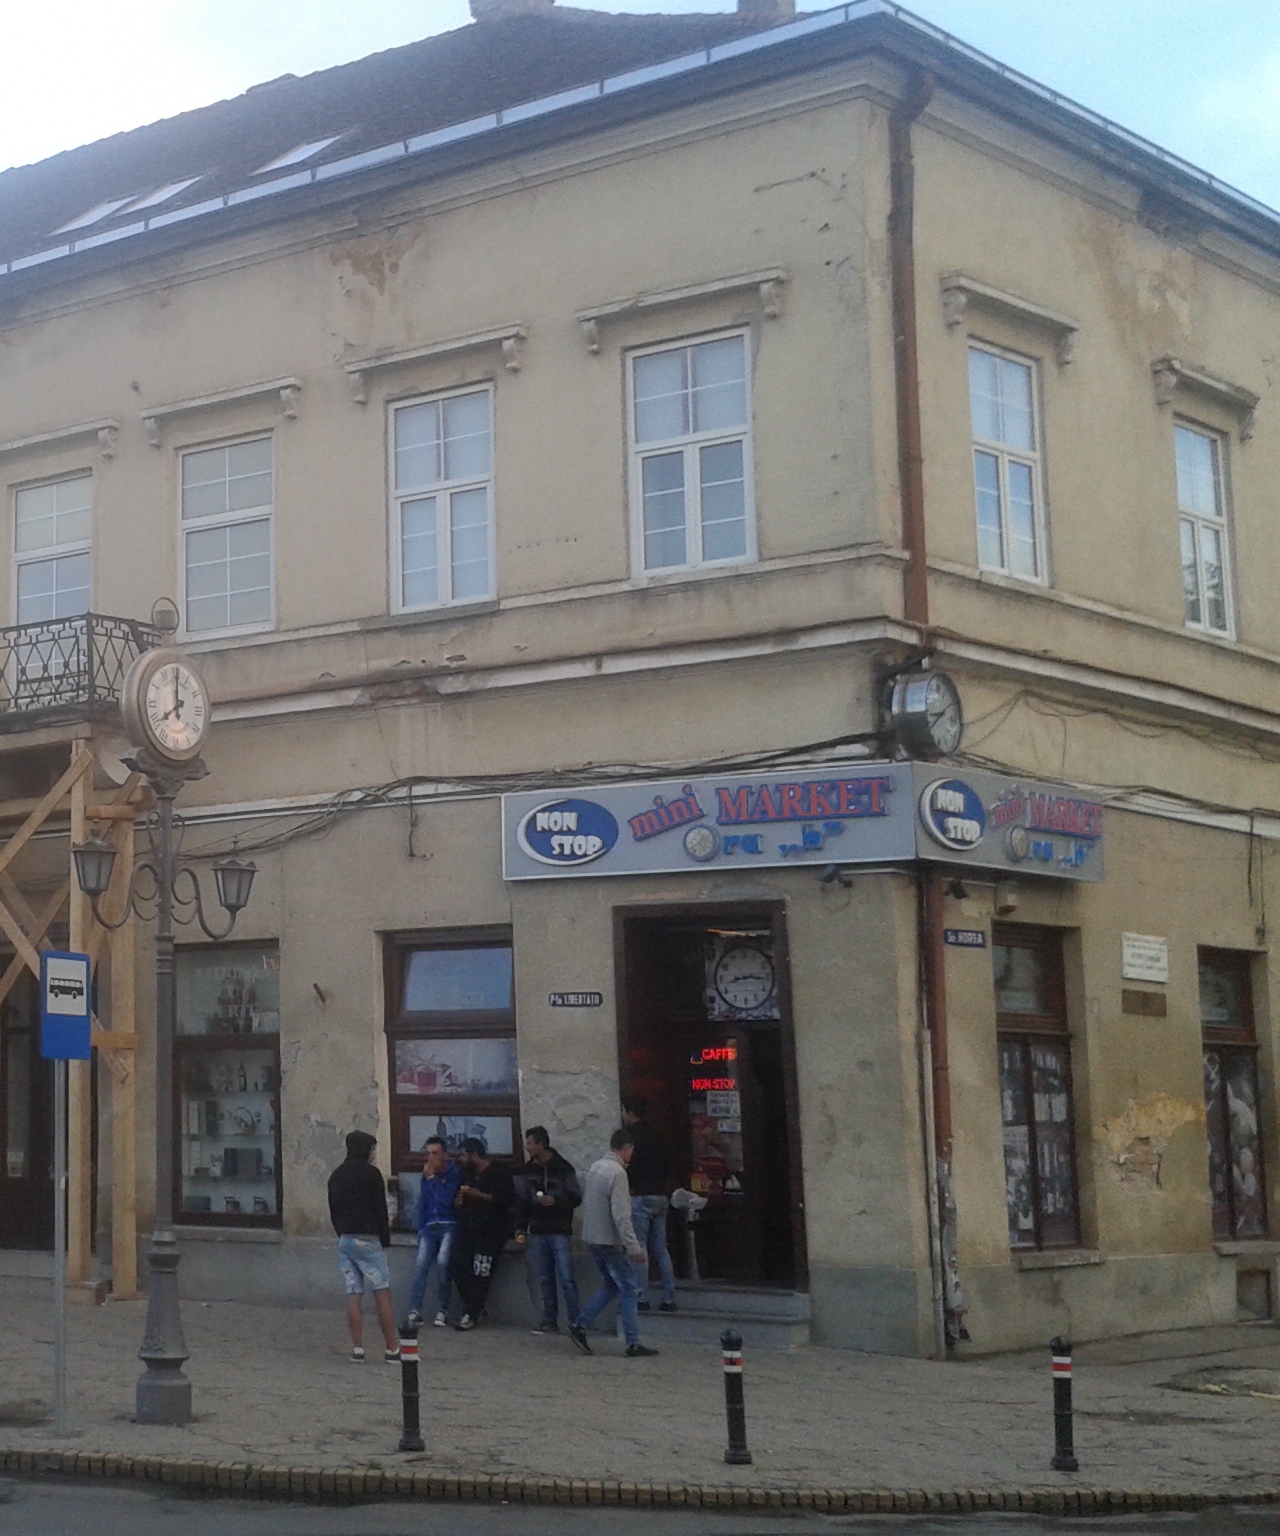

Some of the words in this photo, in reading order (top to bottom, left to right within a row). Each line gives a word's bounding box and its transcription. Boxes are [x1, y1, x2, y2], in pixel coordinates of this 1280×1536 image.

[628, 784, 706, 841] mini
[716, 776, 891, 825] MARKET
[936, 788, 964, 813] NON
[535, 811, 578, 832] NON
[1028, 792, 1103, 839] MARKET
[944, 817, 981, 841] STOP
[550, 834, 603, 857] STOP
